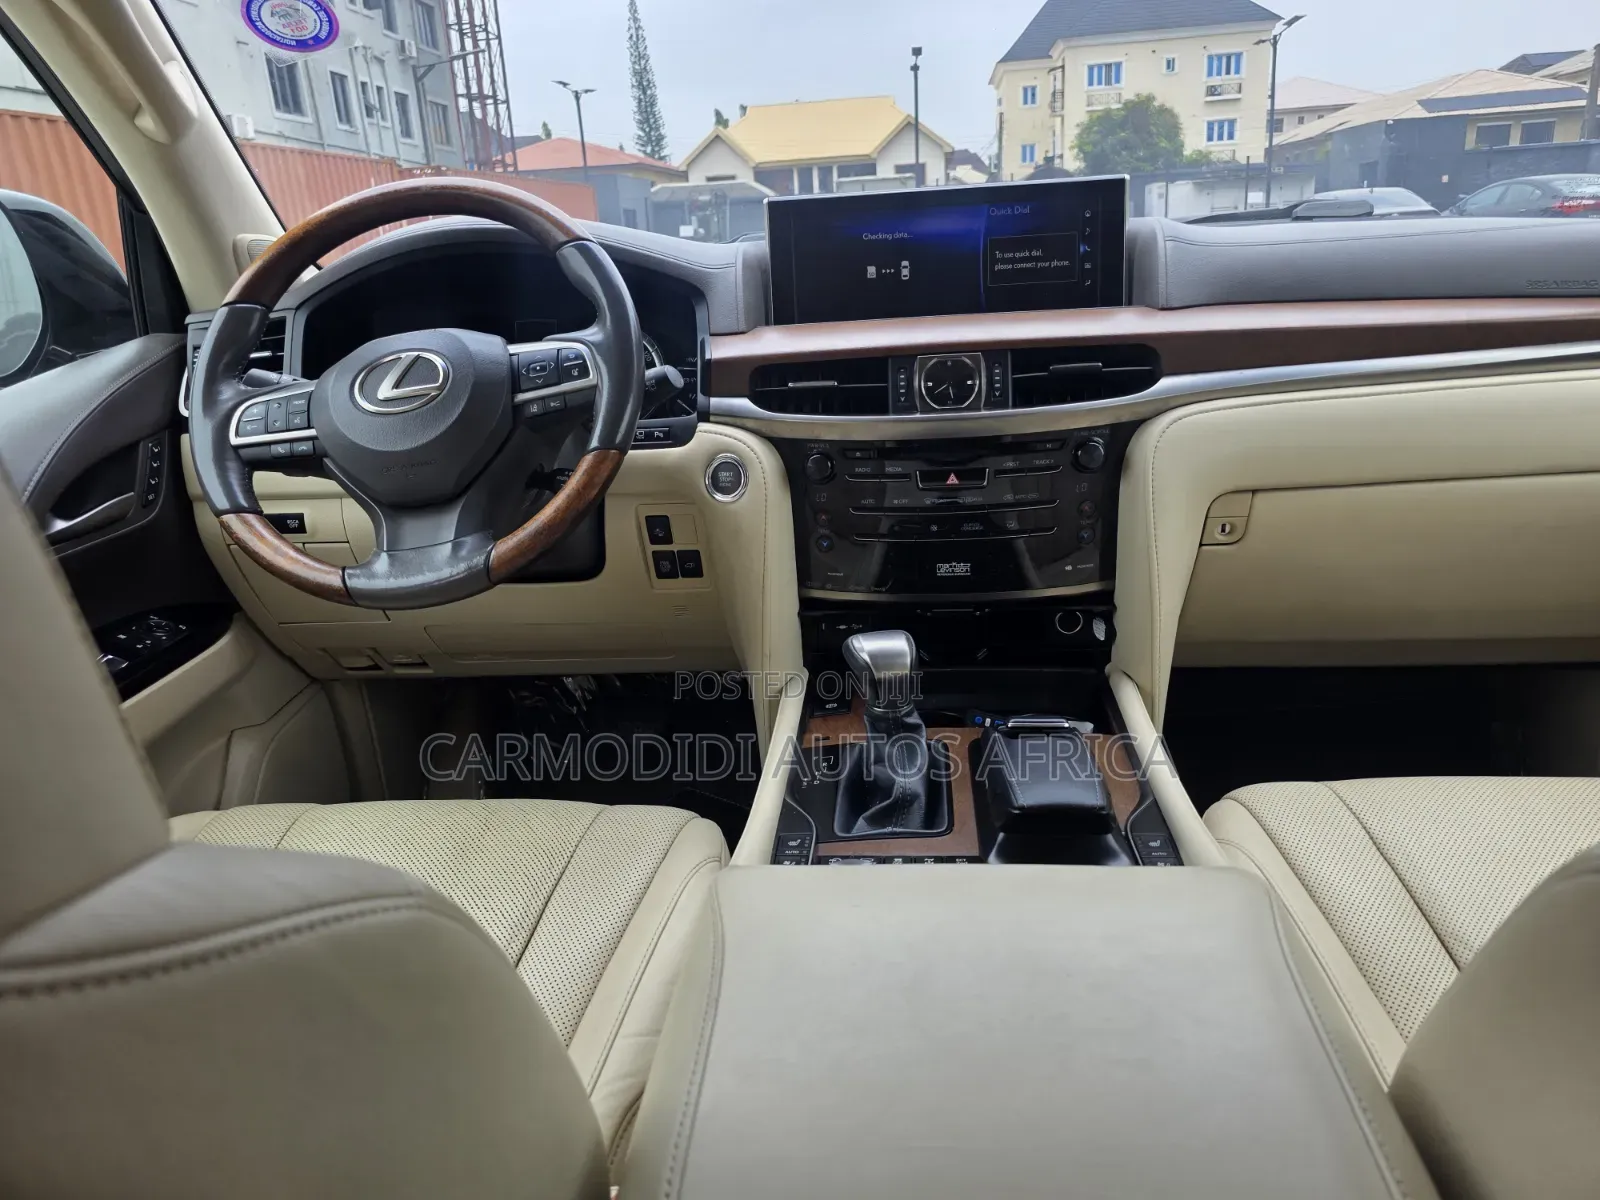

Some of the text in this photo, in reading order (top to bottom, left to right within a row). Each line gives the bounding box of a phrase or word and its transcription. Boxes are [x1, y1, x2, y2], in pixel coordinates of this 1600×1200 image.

[989, 205, 1030, 216] Quick Dial
[862, 232, 892, 240] Checking
[995, 250, 1003, 259] To
[1015, 249, 1030, 259] quick
[995, 258, 1071, 272] please connect your phone.
